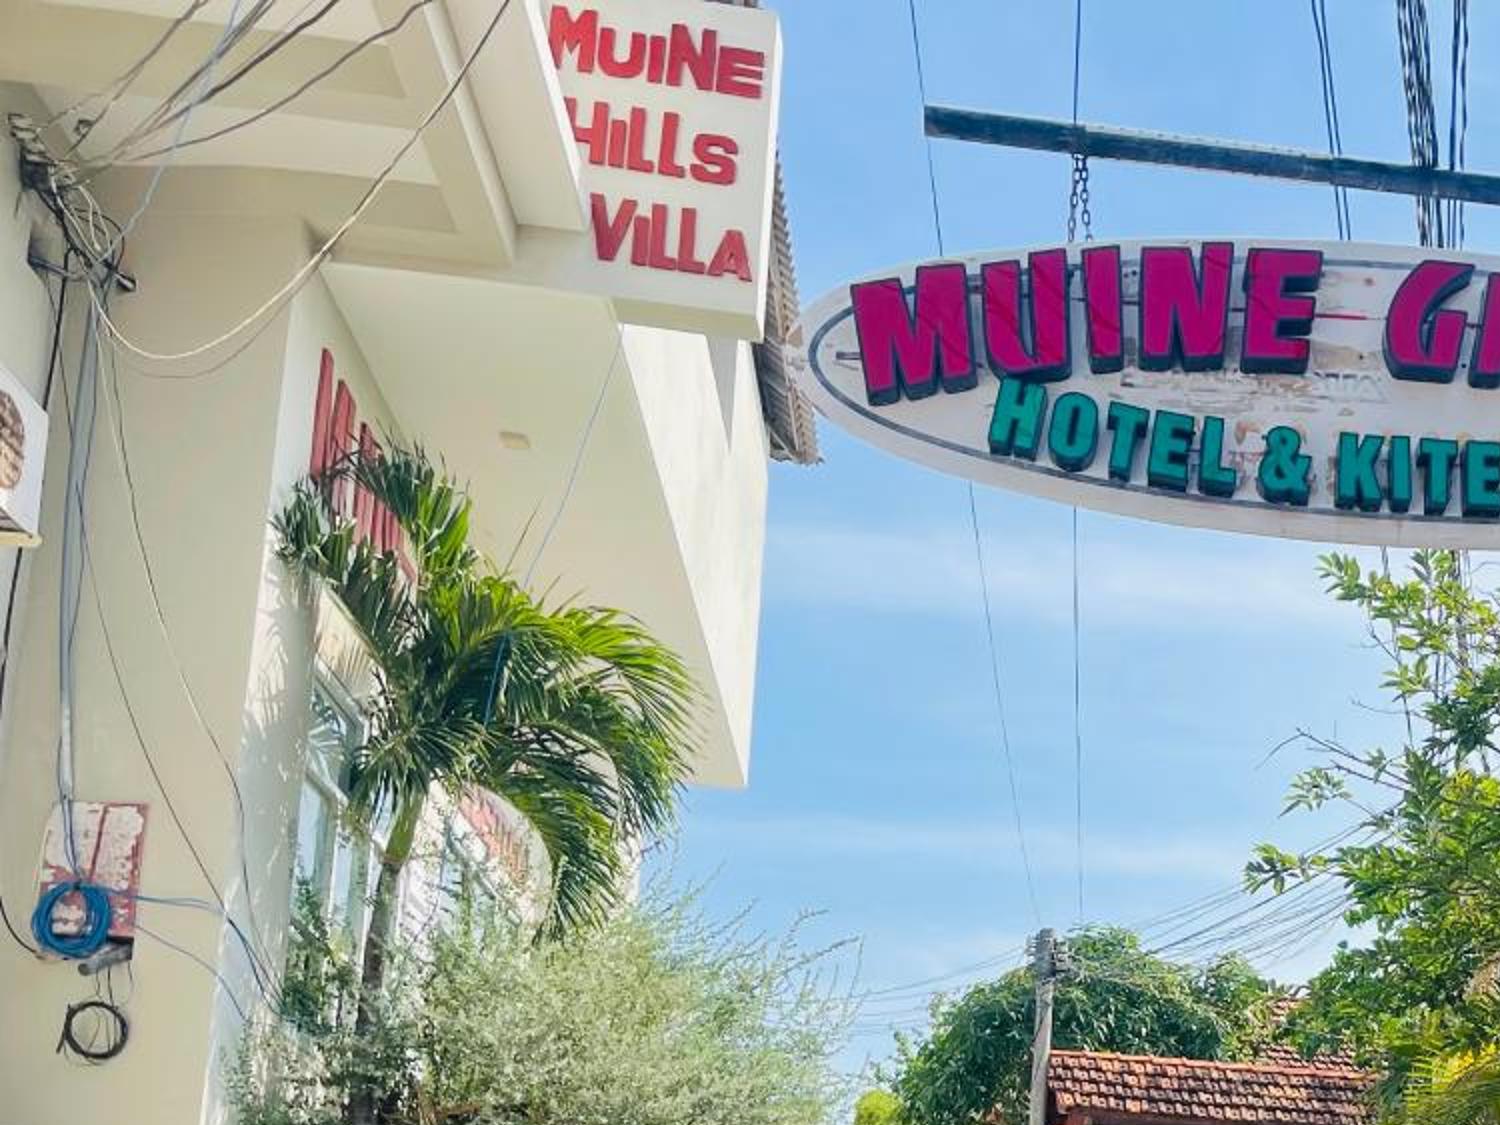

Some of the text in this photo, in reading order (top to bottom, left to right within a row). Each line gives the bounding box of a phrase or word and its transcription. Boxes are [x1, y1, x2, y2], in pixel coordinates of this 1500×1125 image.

[549, 5, 765, 99] MUINE
[563, 96, 738, 185] HILLS
[590, 192, 752, 282] VILLA
[850, 242, 1323, 406] MUINE
[988, 375, 1237, 498] HOTEL
[1258, 425, 1311, 505] &
